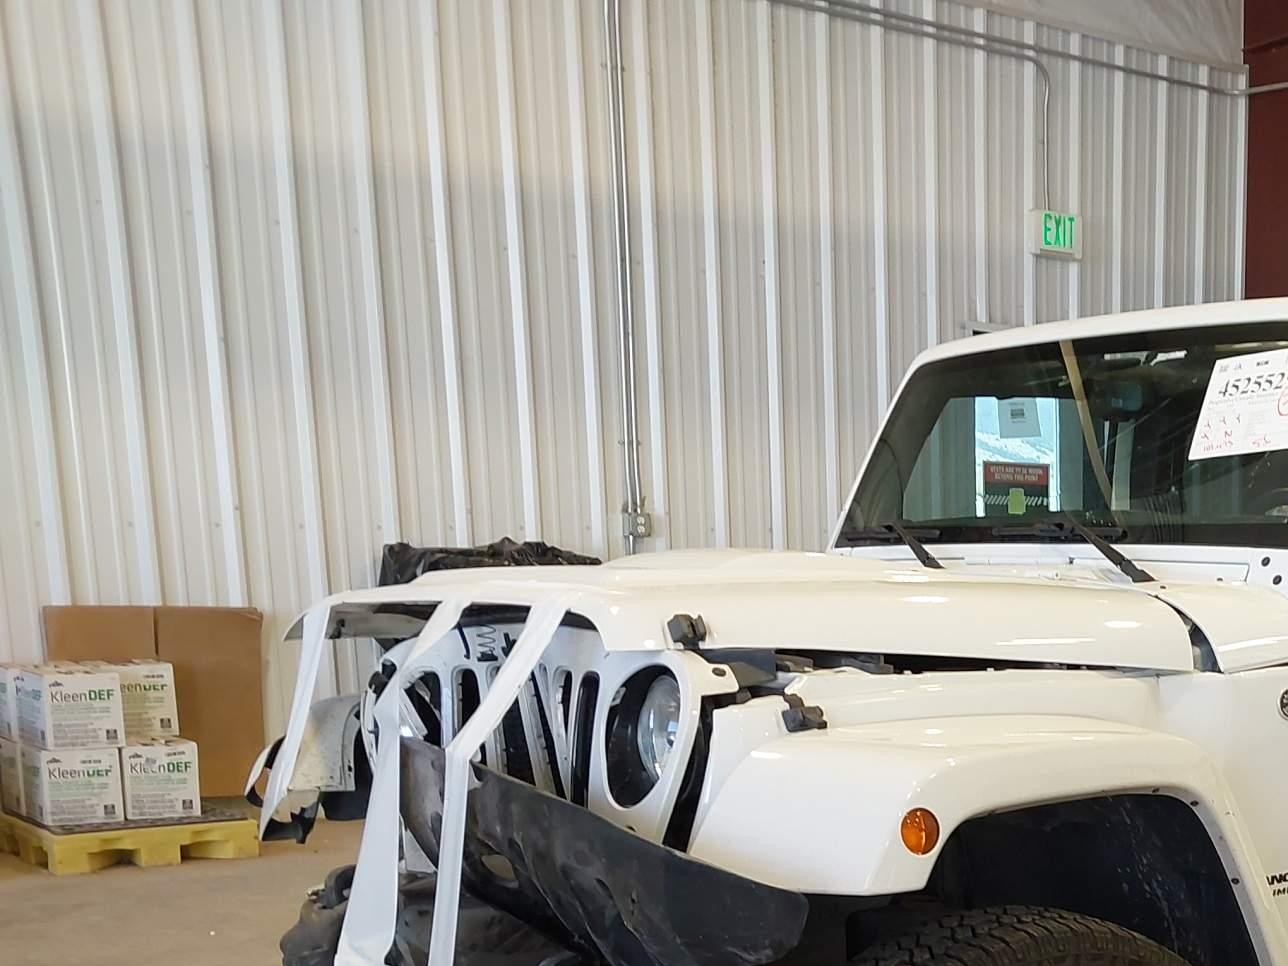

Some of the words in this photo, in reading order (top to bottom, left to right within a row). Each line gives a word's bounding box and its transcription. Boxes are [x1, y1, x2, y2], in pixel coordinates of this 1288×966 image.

[1044, 213, 1075, 249] EXIT
[50, 688, 115, 703] KleenDEF
[120, 683, 168, 693] eenDEF
